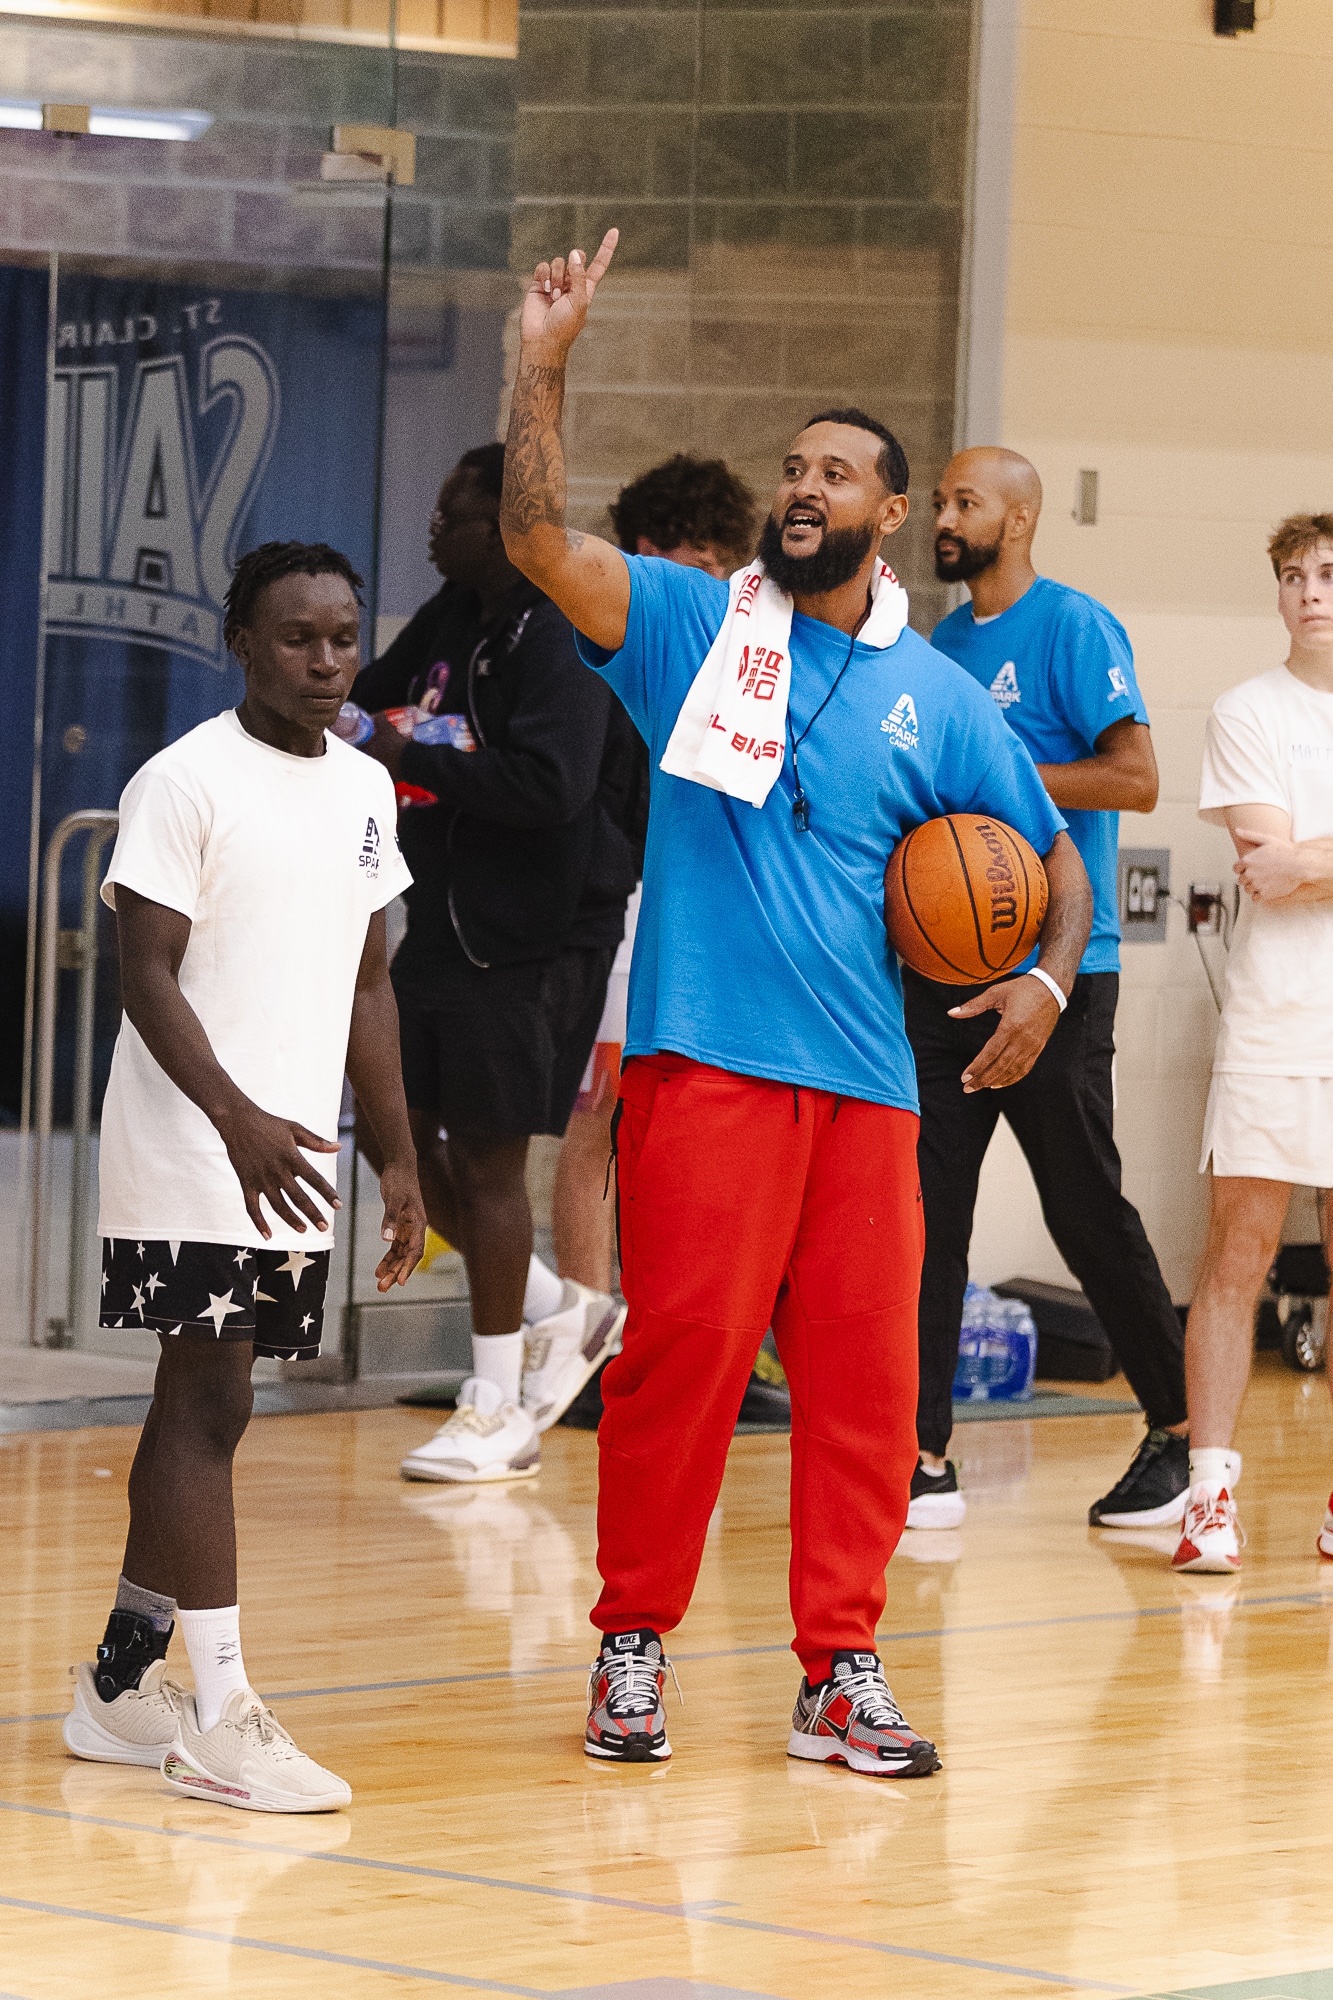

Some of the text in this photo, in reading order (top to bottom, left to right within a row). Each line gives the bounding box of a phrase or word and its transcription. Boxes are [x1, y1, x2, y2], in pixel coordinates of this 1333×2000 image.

[742, 646, 767, 697] STEEL
[989, 690, 1022, 703] PARK
[879, 719, 920, 750] SPARK
[888, 735, 910, 752] CAMP
[974, 823, 1018, 934] Wilson
[618, 1634, 637, 1646] NIKE
[858, 1655, 872, 1664] NIKE
